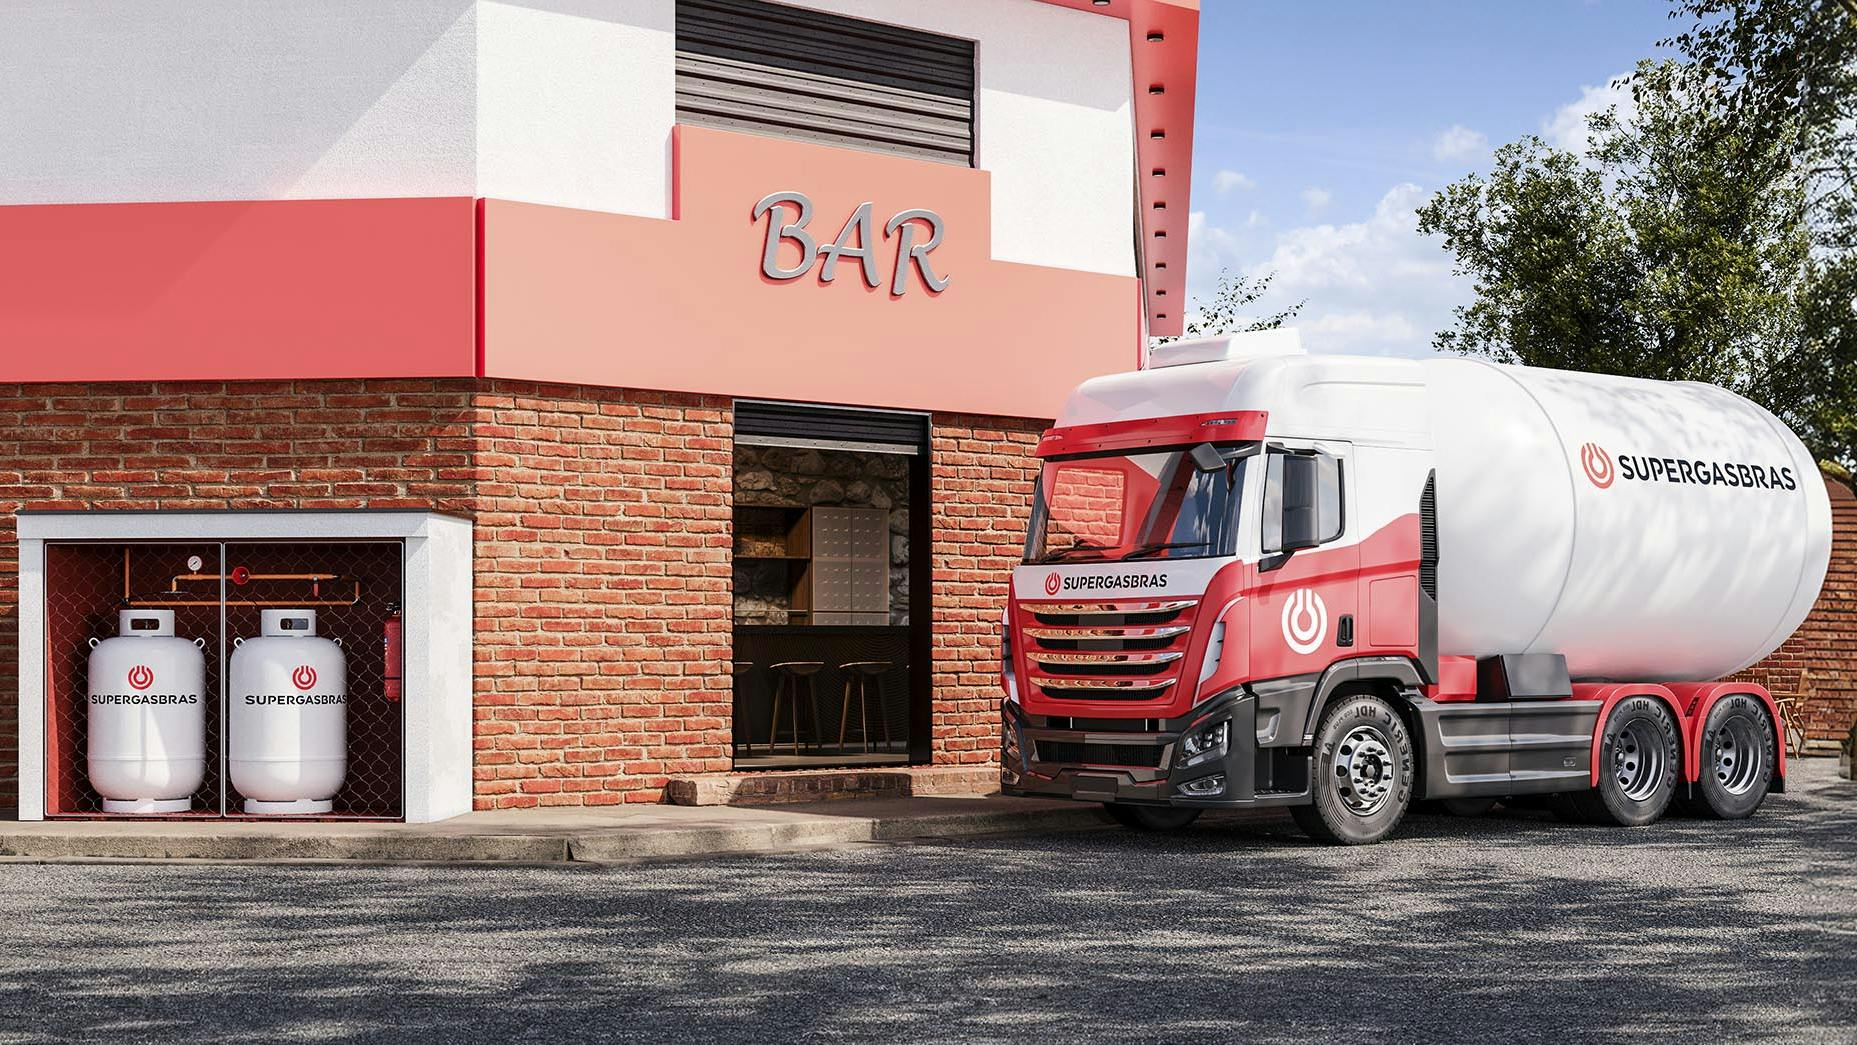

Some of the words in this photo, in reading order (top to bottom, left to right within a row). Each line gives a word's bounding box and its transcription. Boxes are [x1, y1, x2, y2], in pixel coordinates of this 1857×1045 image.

[753, 191, 950, 296] BAR
[1618, 454, 1797, 491] SUPERGASBRAS
[1063, 573, 1168, 590] SUPERGASBRAS
[91, 693, 198, 705] SUPERGASBRAS
[244, 694, 347, 705] SUPERGASBRAS
